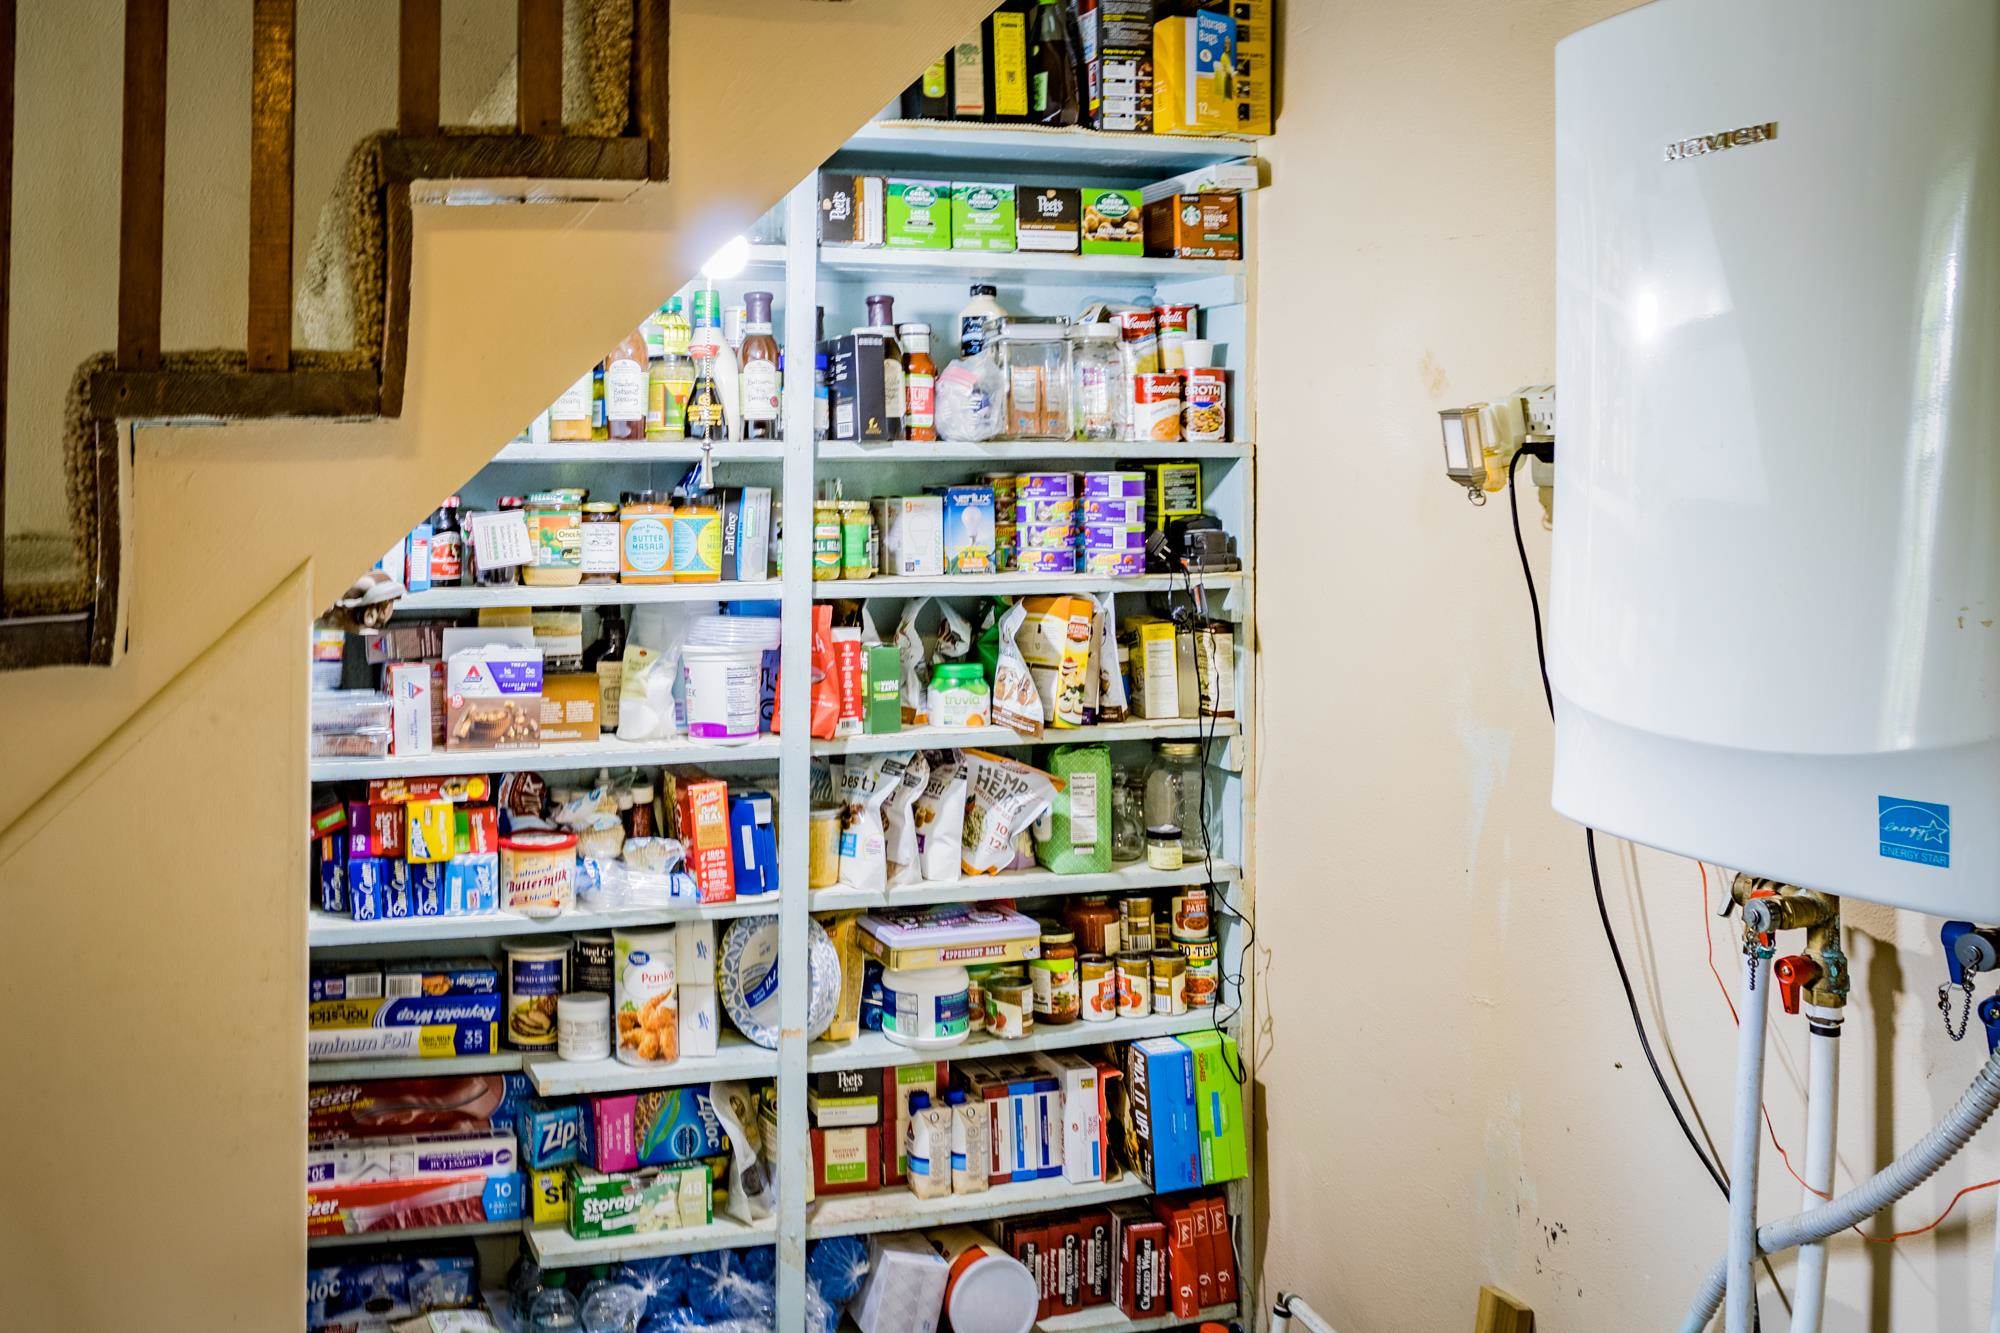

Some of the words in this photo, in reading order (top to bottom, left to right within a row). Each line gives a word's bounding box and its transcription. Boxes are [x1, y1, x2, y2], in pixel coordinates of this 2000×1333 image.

[1037, 195, 1063, 212] Peet's
[725, 512, 738, 535] Grey
[632, 535, 664, 543] BUTTER
[724, 536, 735, 556] Earl
[978, 764, 1029, 795] HEMP
[976, 775, 1023, 815] HEARTS
[1882, 845, 1920, 860] ENERGY
[1921, 852, 1947, 865] STAR
[508, 870, 568, 893] Buttermilk
[641, 970, 675, 984] Panko
[397, 1006, 433, 1024] Wrap
[434, 1004, 496, 1024] Reynolds
[383, 1031, 413, 1051] Foil
[464, 1029, 483, 1045] 35
[1133, 1049, 1146, 1089] MIX
[838, 1071, 863, 1089] Peet's
[1134, 1091, 1147, 1109] IT
[1134, 1109, 1149, 1140] UP!
[494, 1183, 512, 1197] 10
[684, 1183, 703, 1196] 48
[583, 1193, 643, 1214] Storage
[1141, 1238, 1152, 1270] WHEAT
[1140, 1270, 1151, 1310] CRACKED
